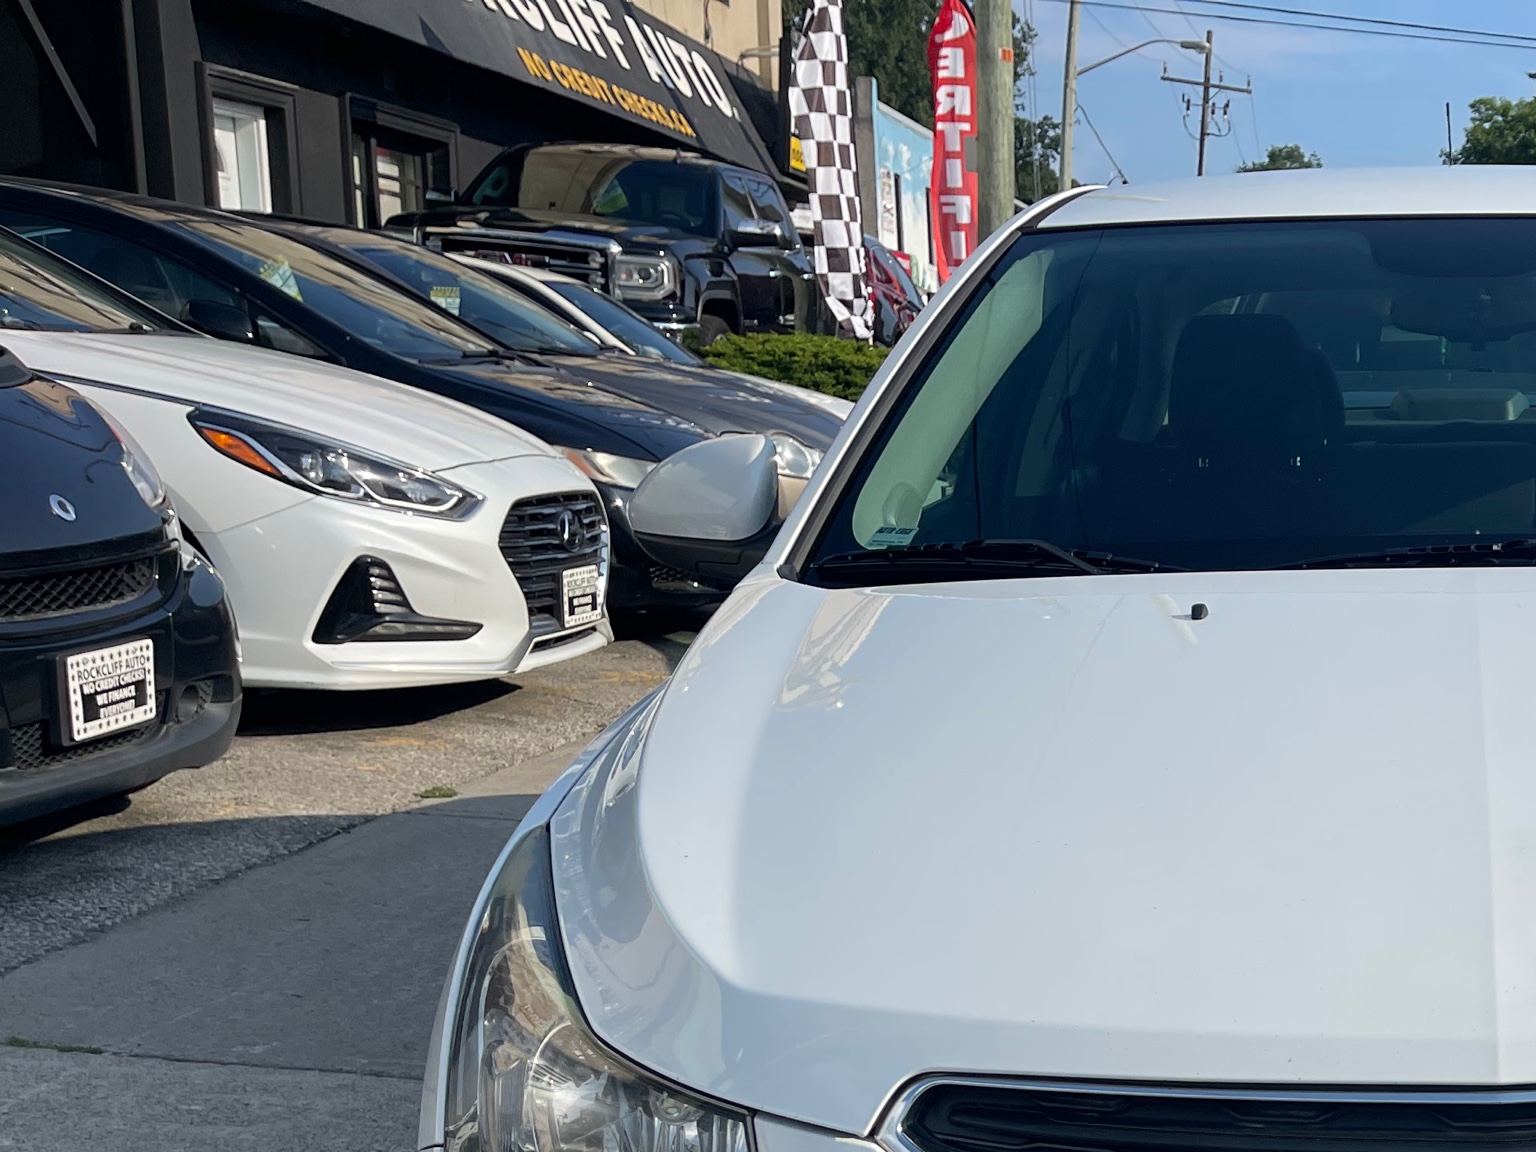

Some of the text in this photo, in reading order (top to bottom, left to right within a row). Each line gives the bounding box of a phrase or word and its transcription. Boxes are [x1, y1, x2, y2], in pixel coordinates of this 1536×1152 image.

[466, 0, 631, 70] CLIFF
[517, 46, 553, 82] NO
[550, 60, 616, 105] CREDIT
[77, 654, 146, 682] ROCKCLIFF AUTO
[82, 683, 96, 696] NO
[95, 675, 120, 692] CREDIT
[96, 685, 137, 706] WE FINANCE
